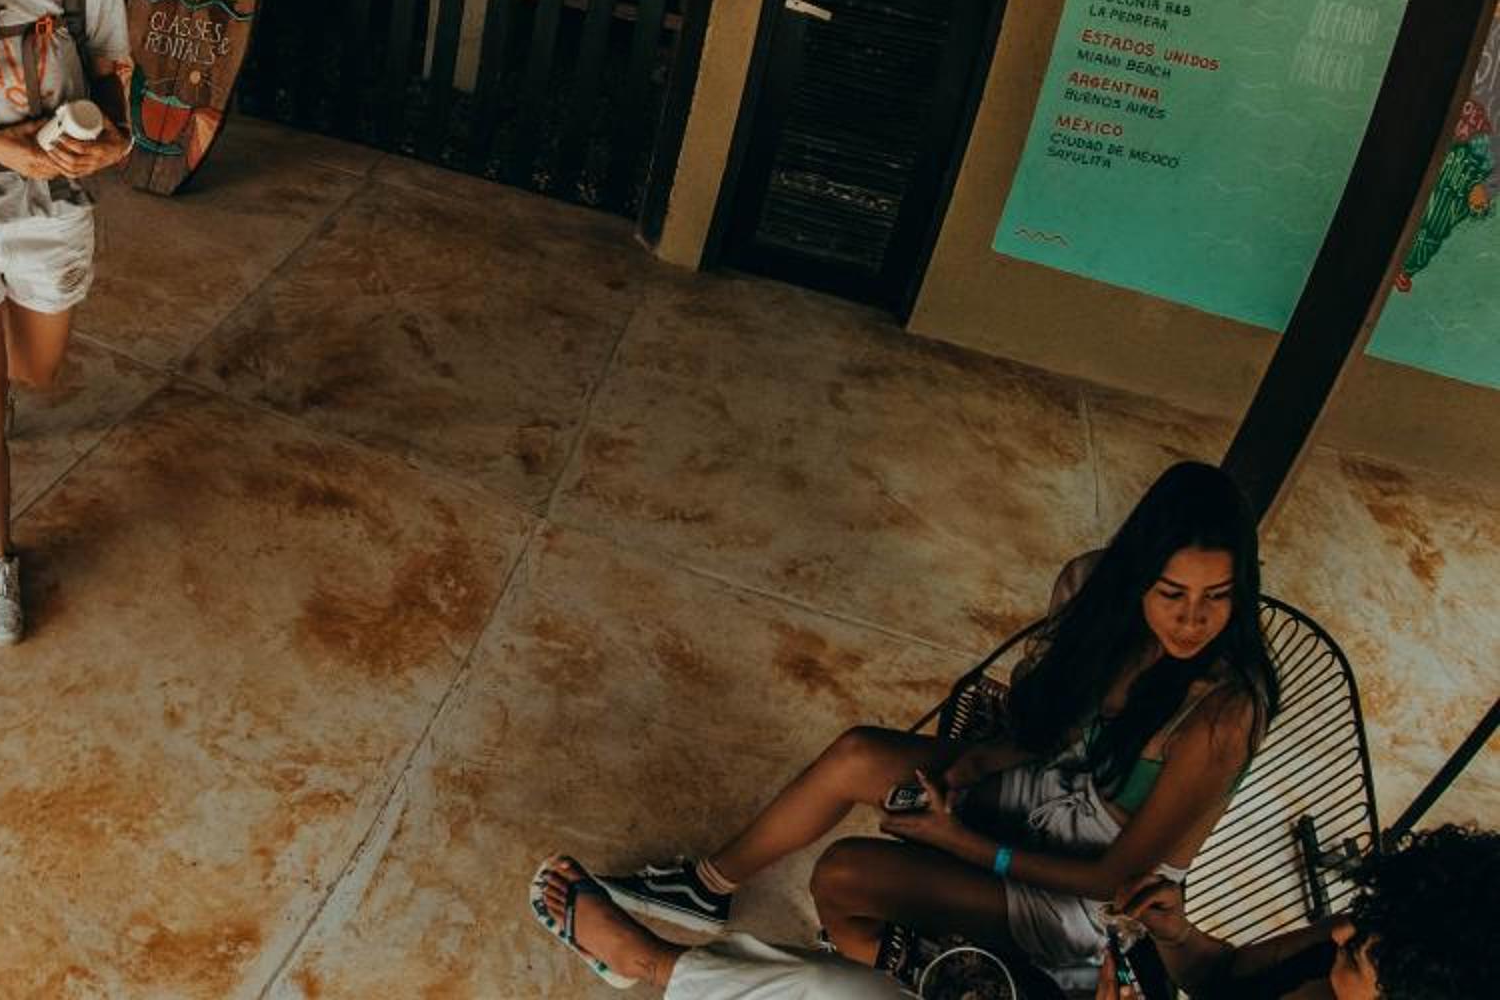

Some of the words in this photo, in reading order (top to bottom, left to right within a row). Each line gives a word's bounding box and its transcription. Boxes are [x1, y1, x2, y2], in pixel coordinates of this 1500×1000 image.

[1089, 4, 1106, 18] LA
[1109, 8, 1169, 31] PEDRERA
[145, 32, 215, 65] RENTALS
[1076, 49, 1122, 67] MIAMI
[1125, 59, 1172, 79] BEACH
[1081, 29, 1156, 57] ESTADOS
[1163, 48, 1221, 71] UNIDOS
[1067, 71, 1161, 102] ARGENTINA
[1064, 87, 1122, 109] BUENOS
[1125, 103, 1167, 120] AIRES
[1056, 114, 1125, 137] MEXICO
[1047, 147, 1112, 169] SAYULITA
[1050, 132, 1104, 151] CIUDAD
[1107, 143, 1125, 157] DE
[1128, 147, 1180, 169] MEXICO
